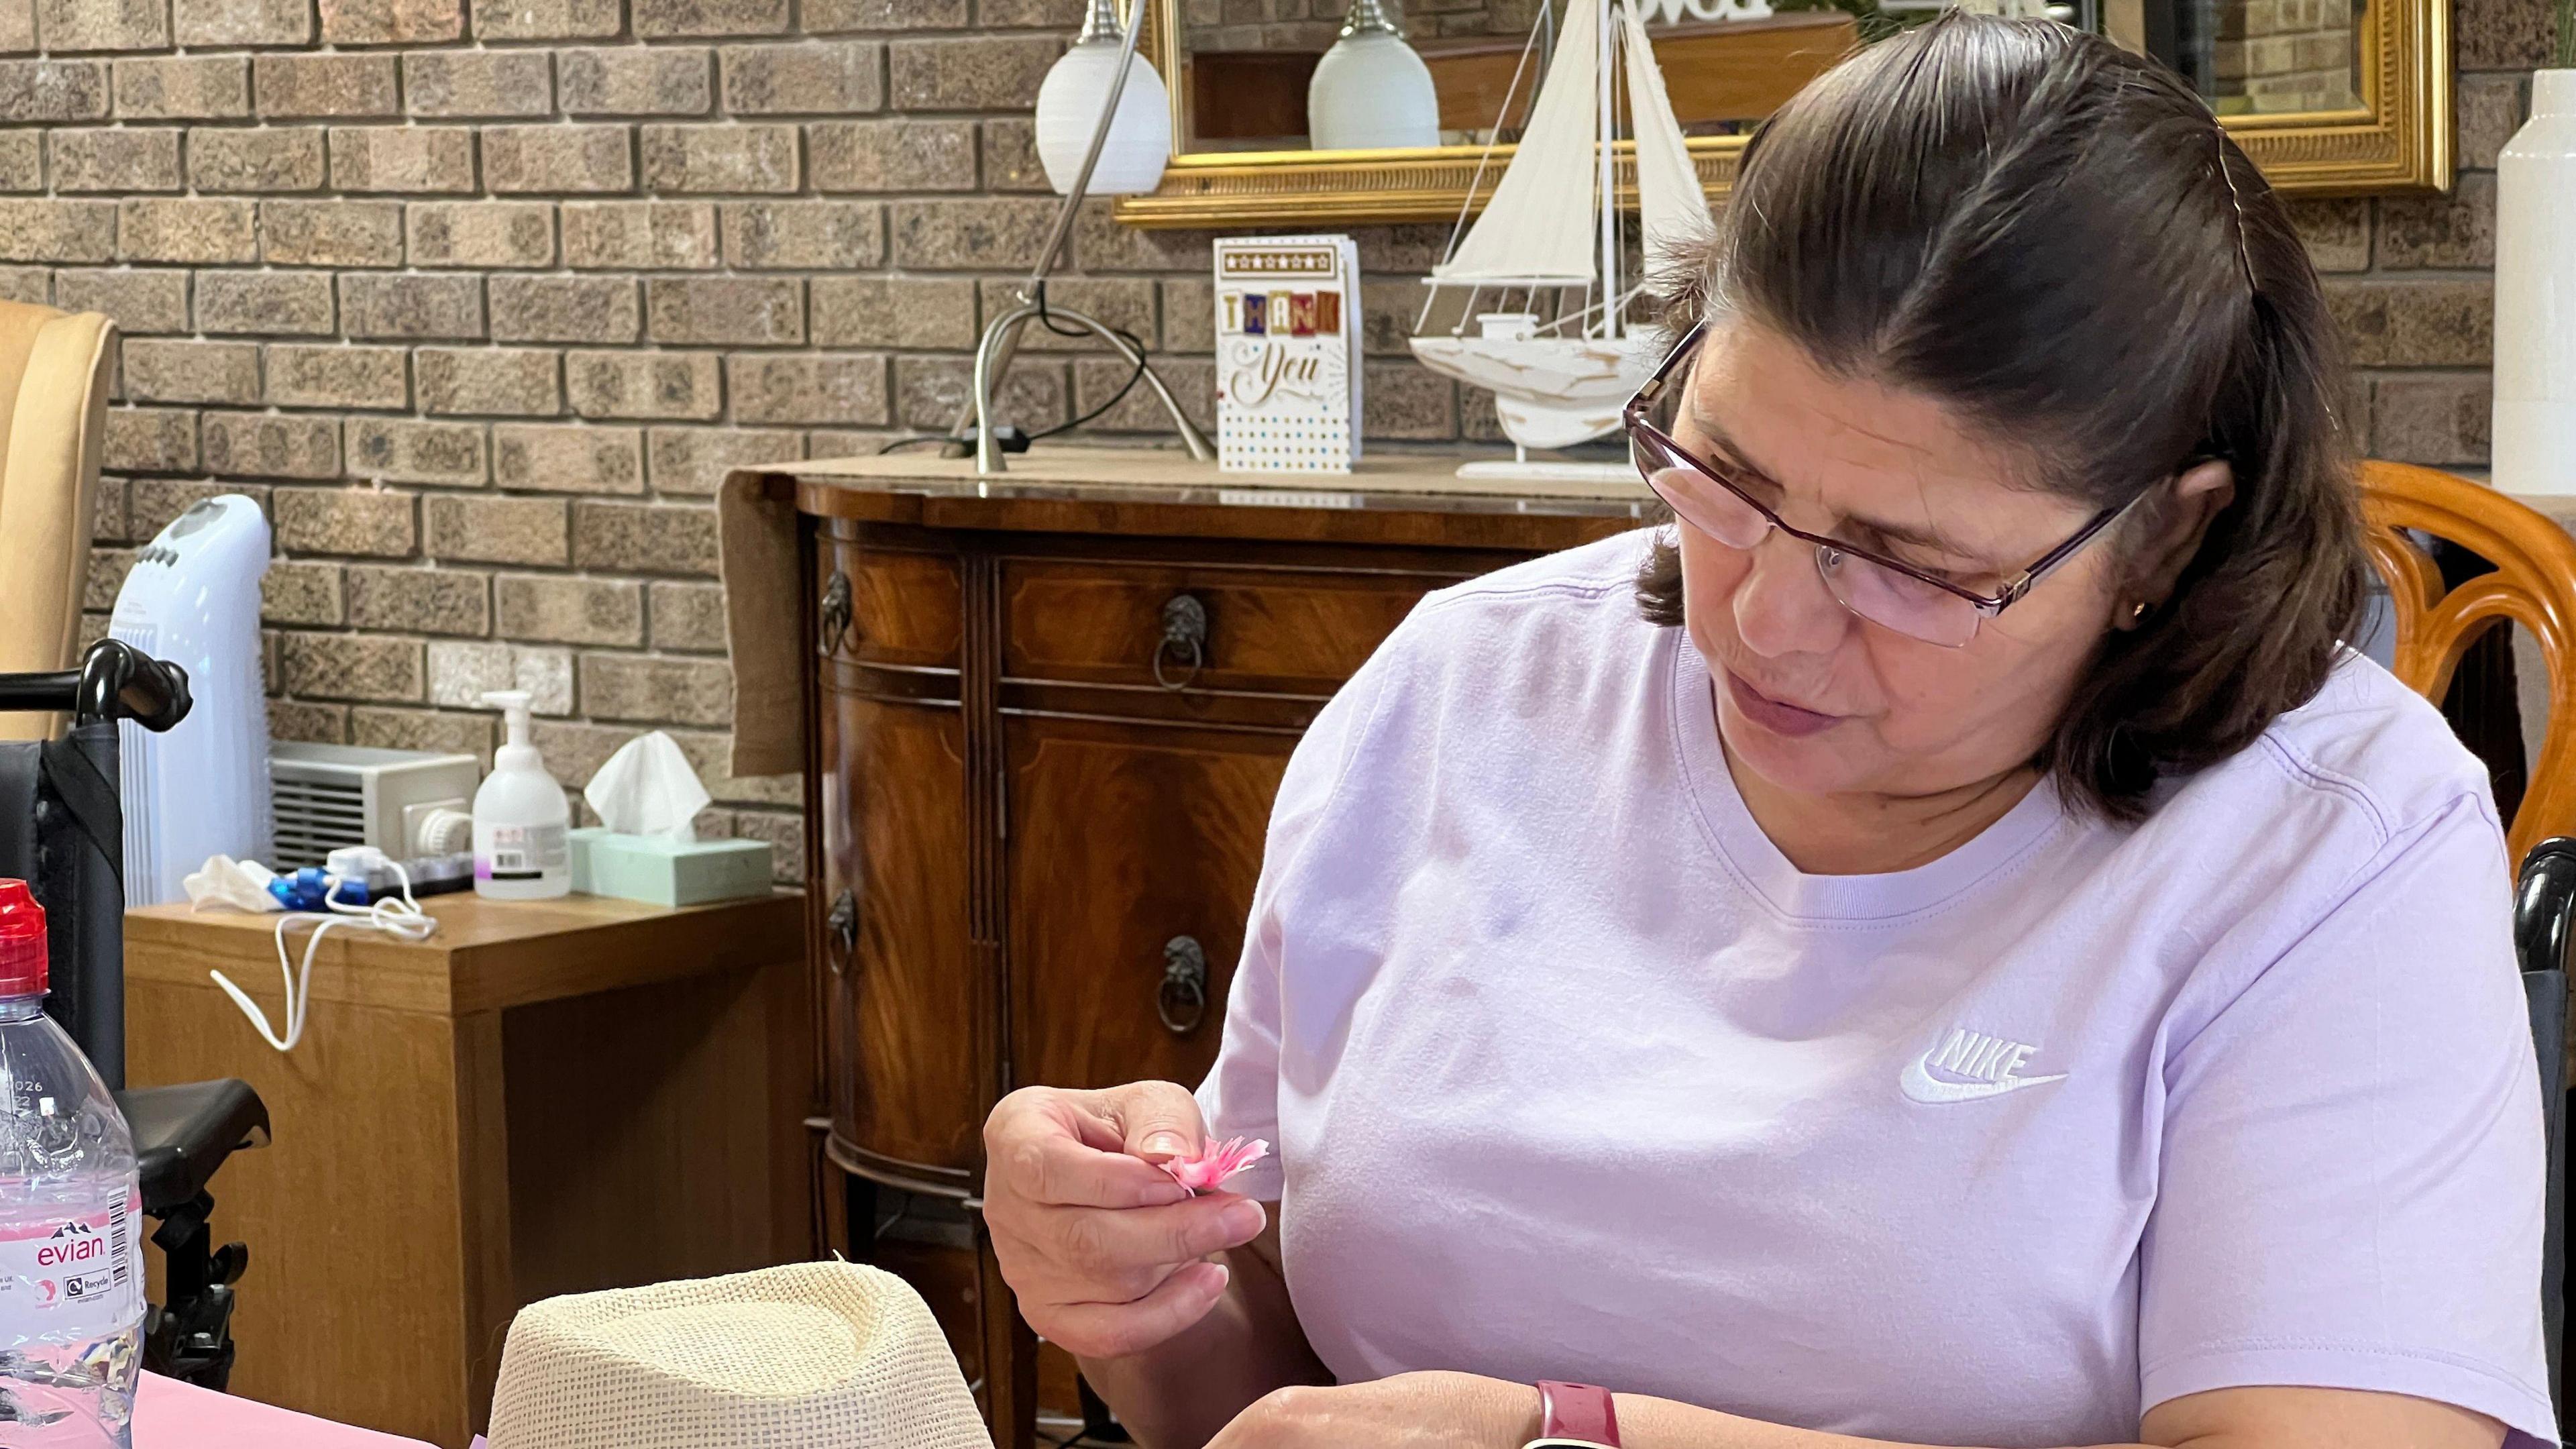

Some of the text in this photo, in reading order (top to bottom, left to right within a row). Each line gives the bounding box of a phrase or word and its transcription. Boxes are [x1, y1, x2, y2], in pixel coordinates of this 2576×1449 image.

[1223, 291, 1340, 336] THANK
[1232, 343, 1320, 408] You
[1927, 1028, 2038, 1082] NIKE
[38, 1238, 103, 1266] evian
[85, 1276, 109, 1289] Recycle
